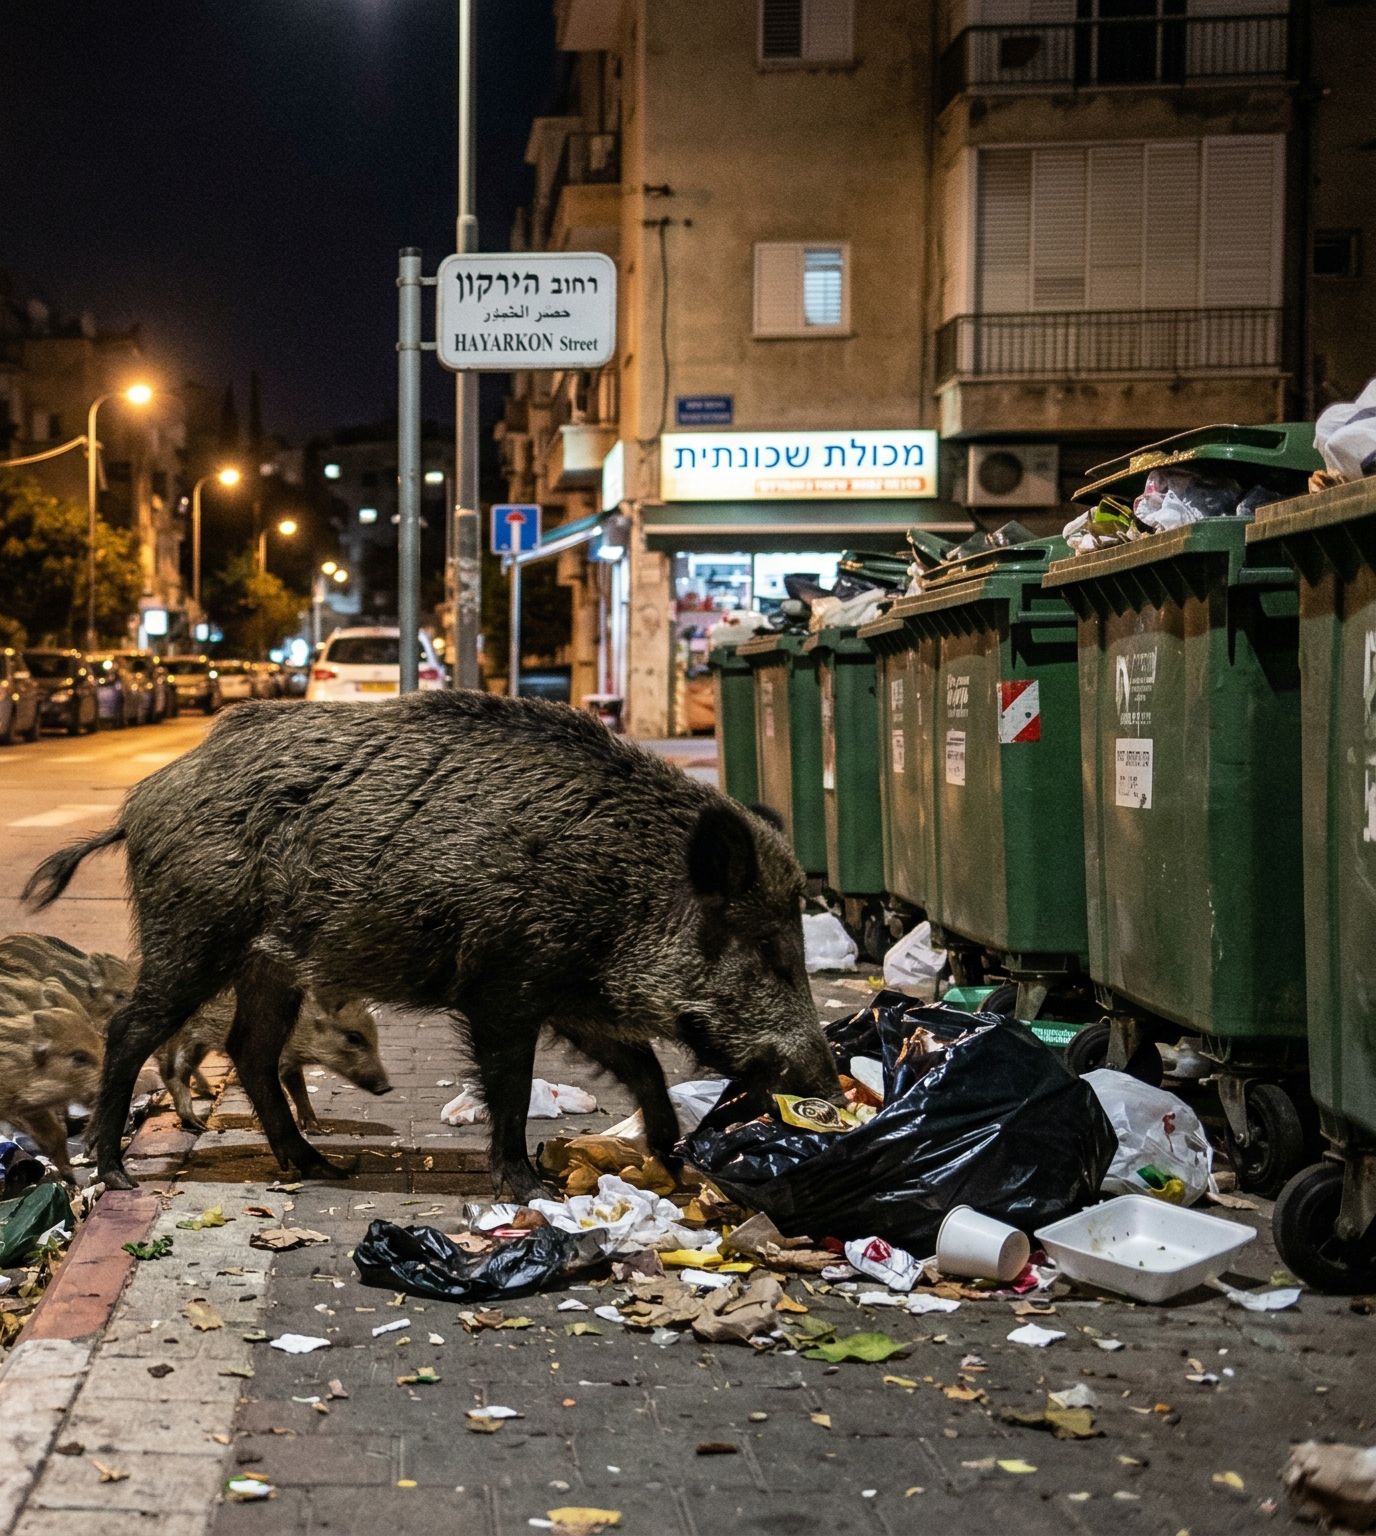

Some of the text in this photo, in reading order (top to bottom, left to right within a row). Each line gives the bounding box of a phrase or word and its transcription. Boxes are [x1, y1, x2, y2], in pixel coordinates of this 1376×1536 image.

[455, 271, 598, 303] רחוב הירקון
[454, 332, 598, 352] HAYARKON Street
[673, 438, 924, 469] מכולת שכונתית
